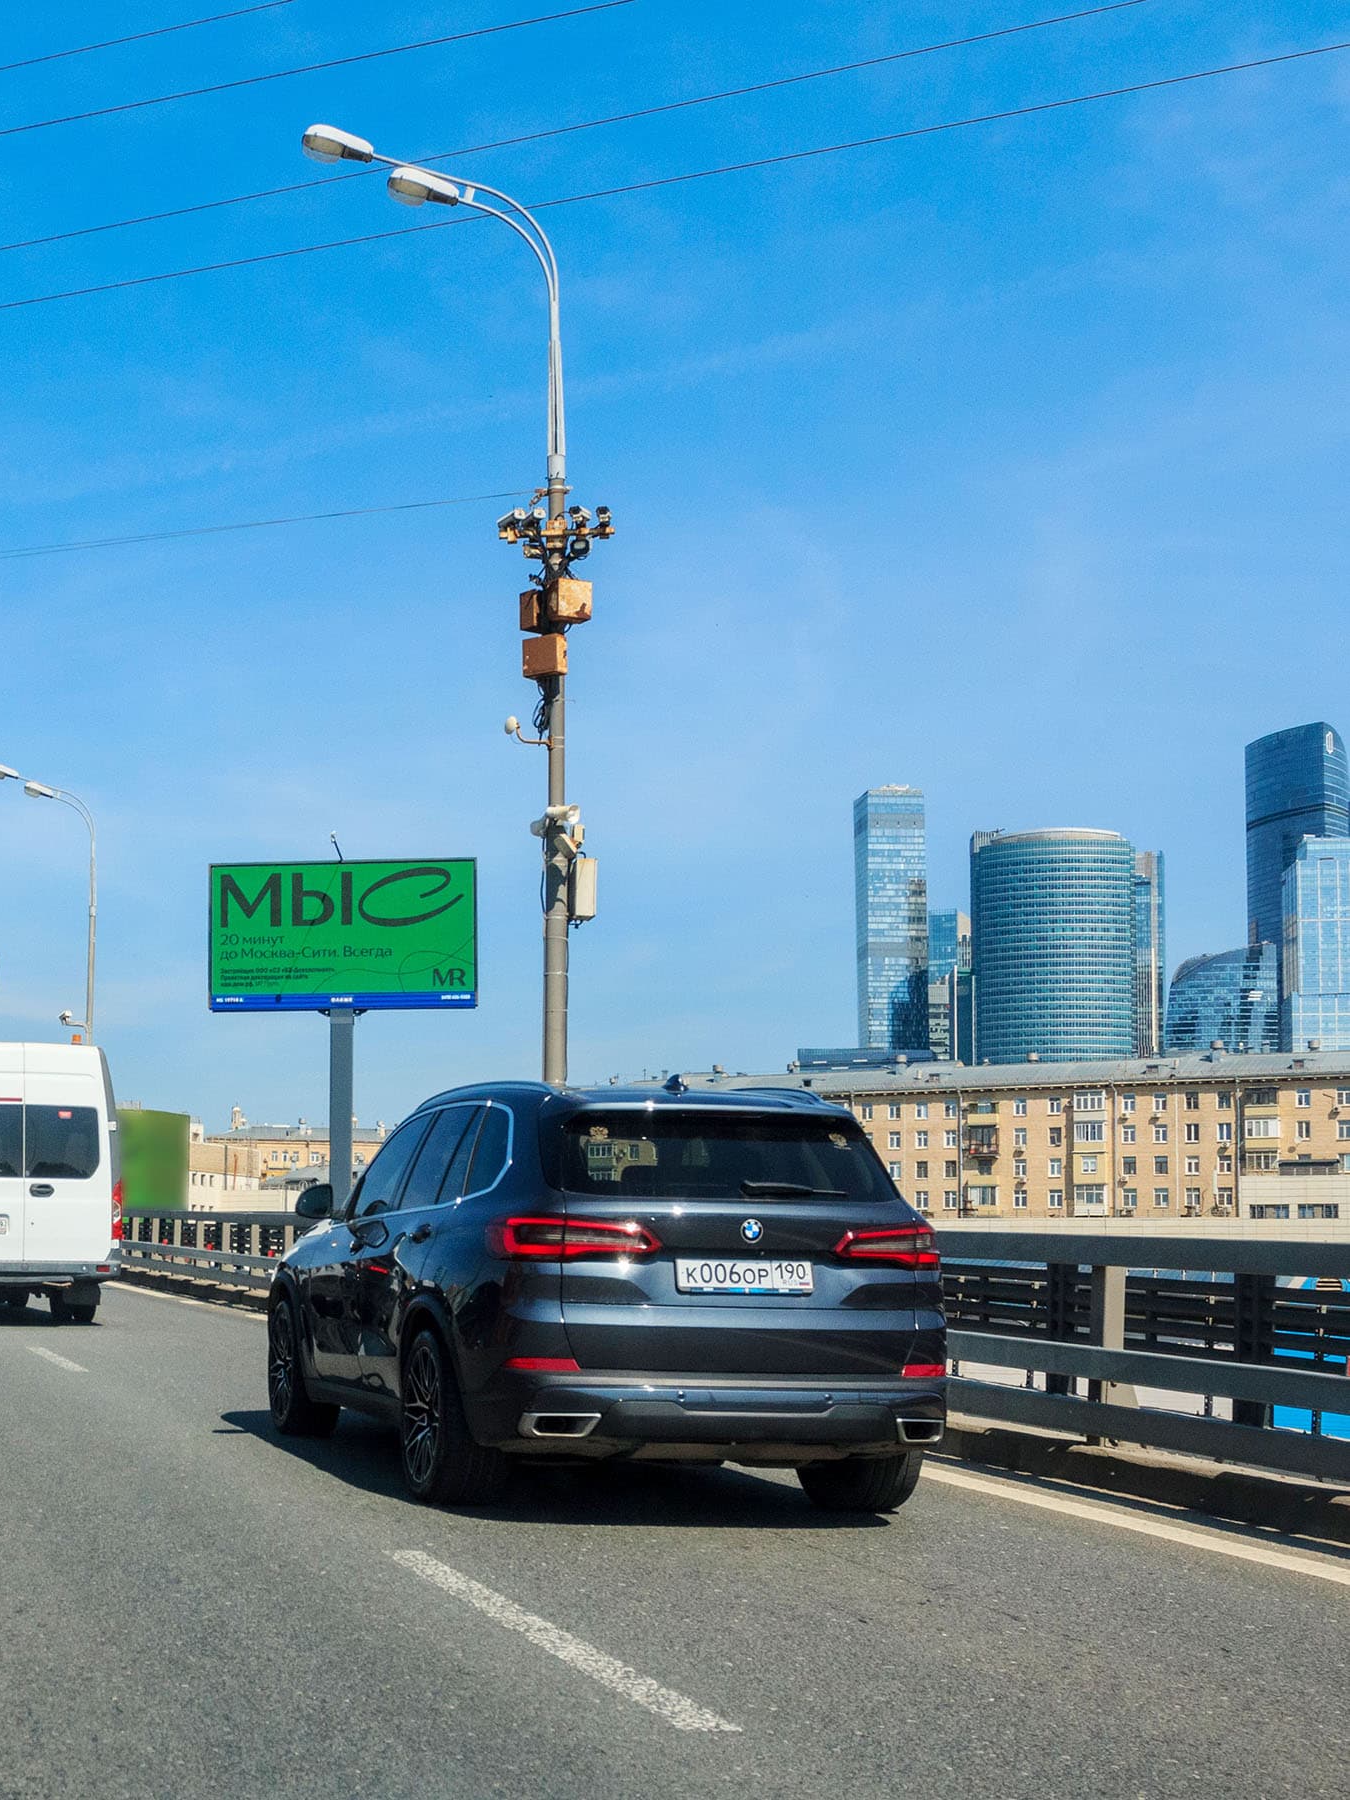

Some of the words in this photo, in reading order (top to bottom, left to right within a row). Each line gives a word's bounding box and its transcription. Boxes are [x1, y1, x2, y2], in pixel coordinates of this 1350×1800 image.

[220, 867, 464, 928] МЫС
[220, 934, 239, 946] 20
[242, 935, 285, 946] минут
[220, 949, 238, 961] до
[343, 946, 393, 959] Всегда
[433, 968, 466, 987] MR
[685, 1263, 769, 1285] К006ОР
[775, 1263, 807, 1280] 190
